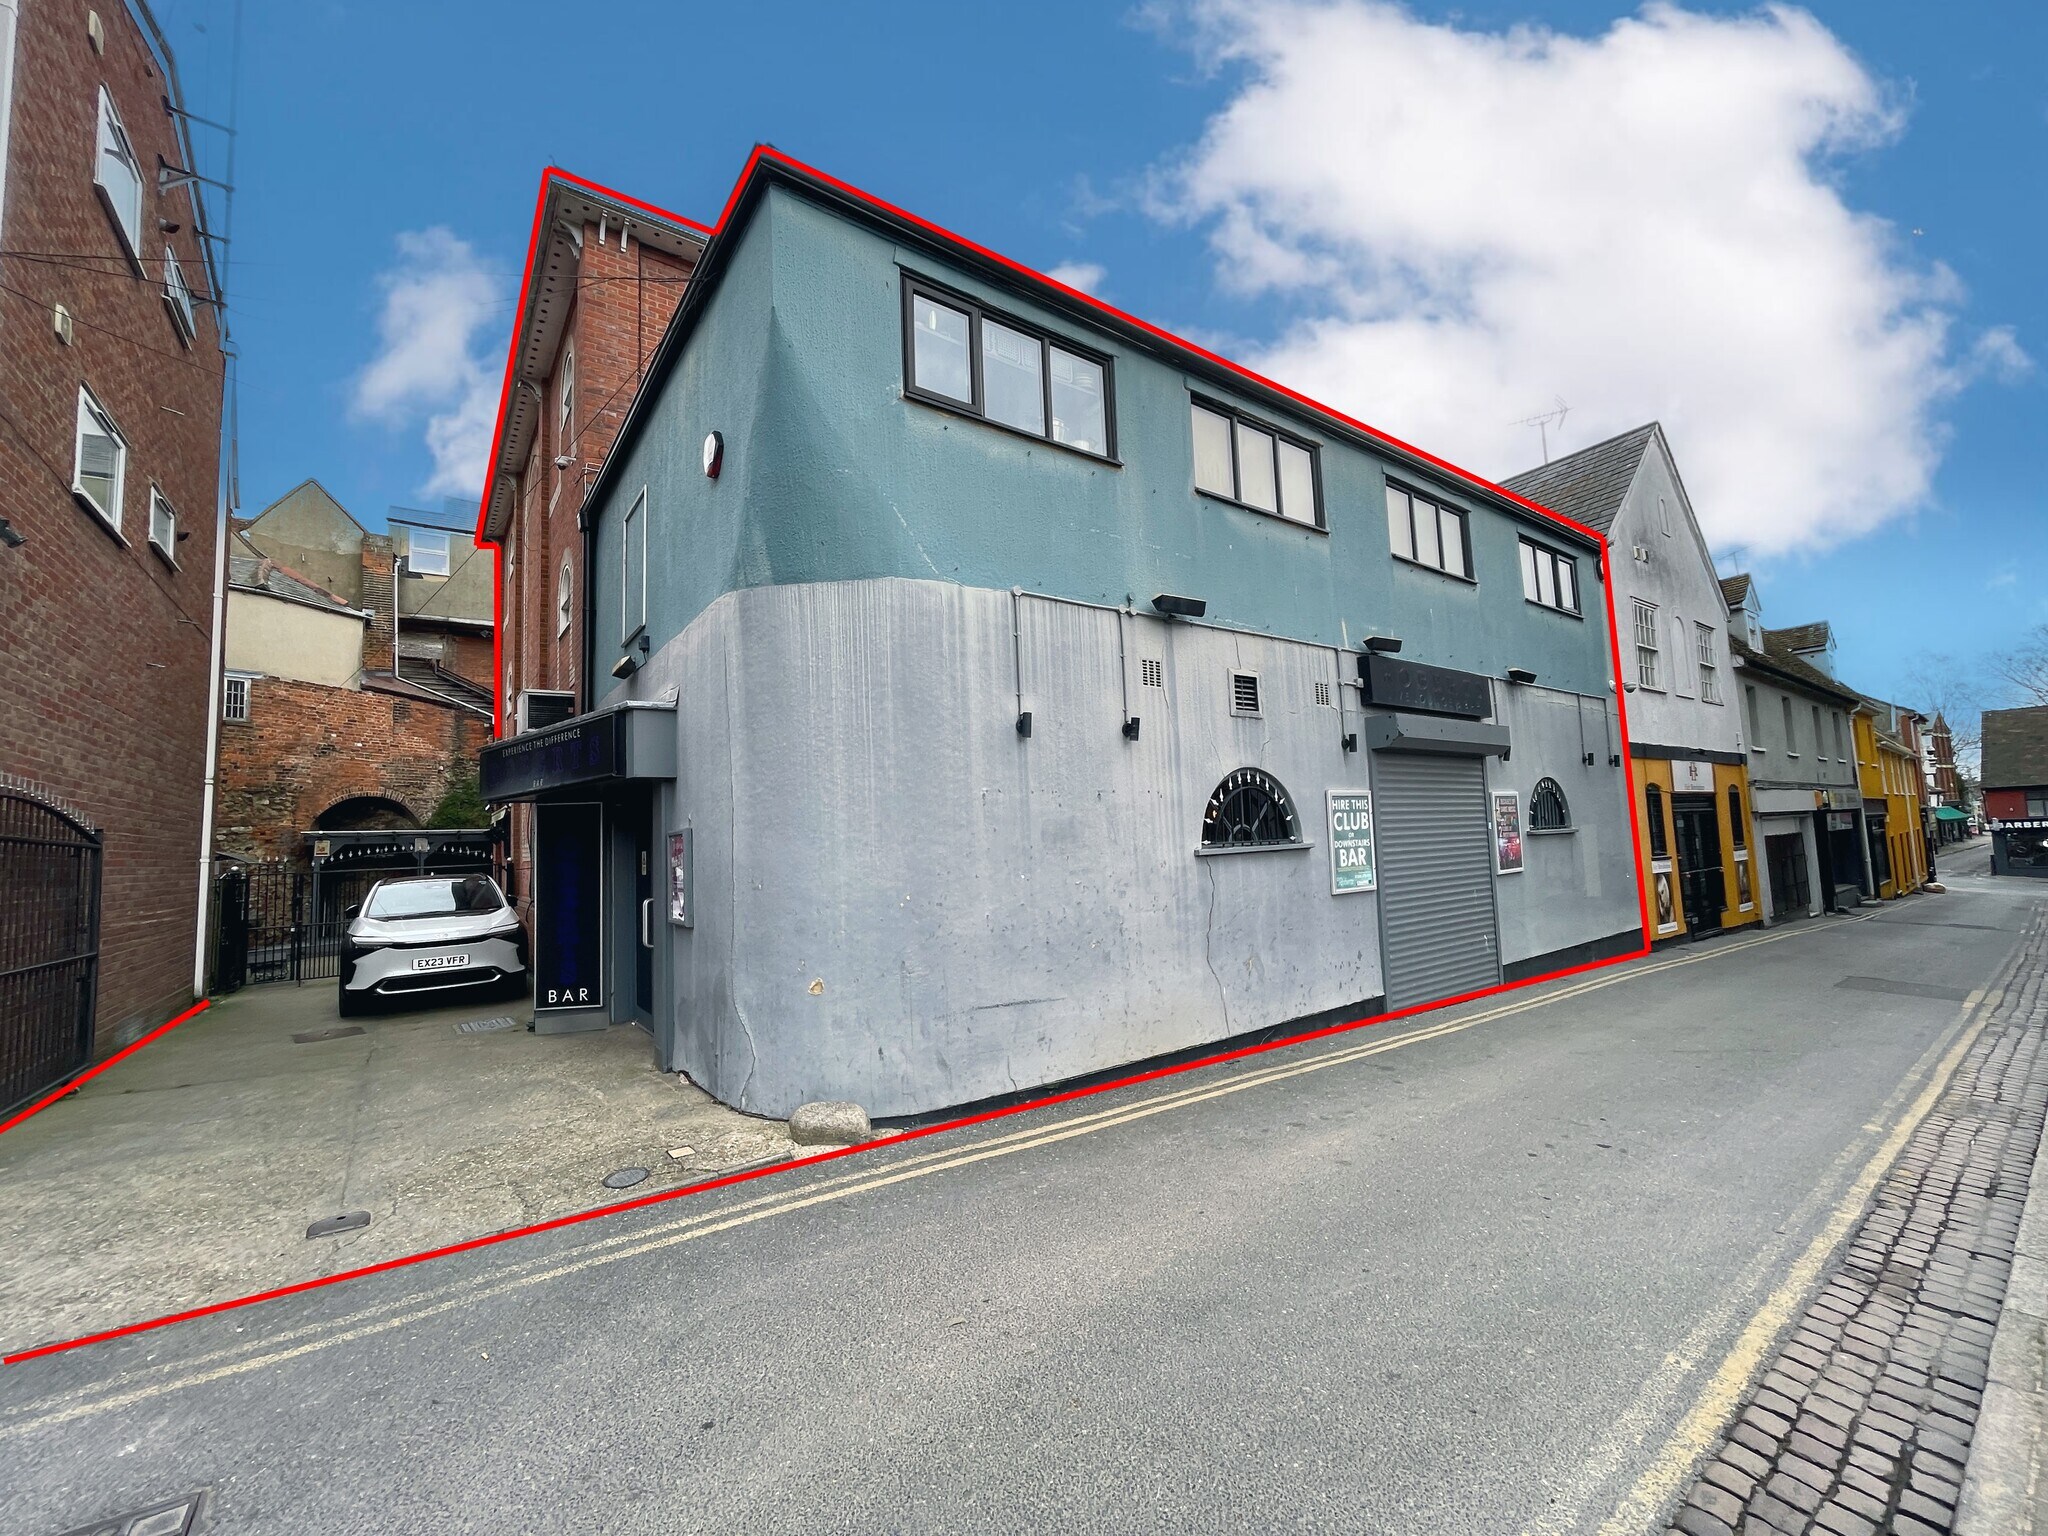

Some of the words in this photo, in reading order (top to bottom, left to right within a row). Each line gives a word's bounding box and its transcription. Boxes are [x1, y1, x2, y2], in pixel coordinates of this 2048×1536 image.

[502, 743, 532, 758] EXPERIENCE
[533, 738, 544, 749] THE
[544, 728, 581, 746] DIFFERENCE
[1332, 799, 1349, 810] HIRE
[1350, 799, 1368, 810] THIS
[1333, 811, 1369, 831] CLUB
[1334, 839, 1370, 848] DOWNSTAIRS
[1339, 847, 1366, 867] BAR
[417, 958, 443, 967] EX23
[446, 956, 465, 965] VFR
[547, 987, 589, 1004] BAR
